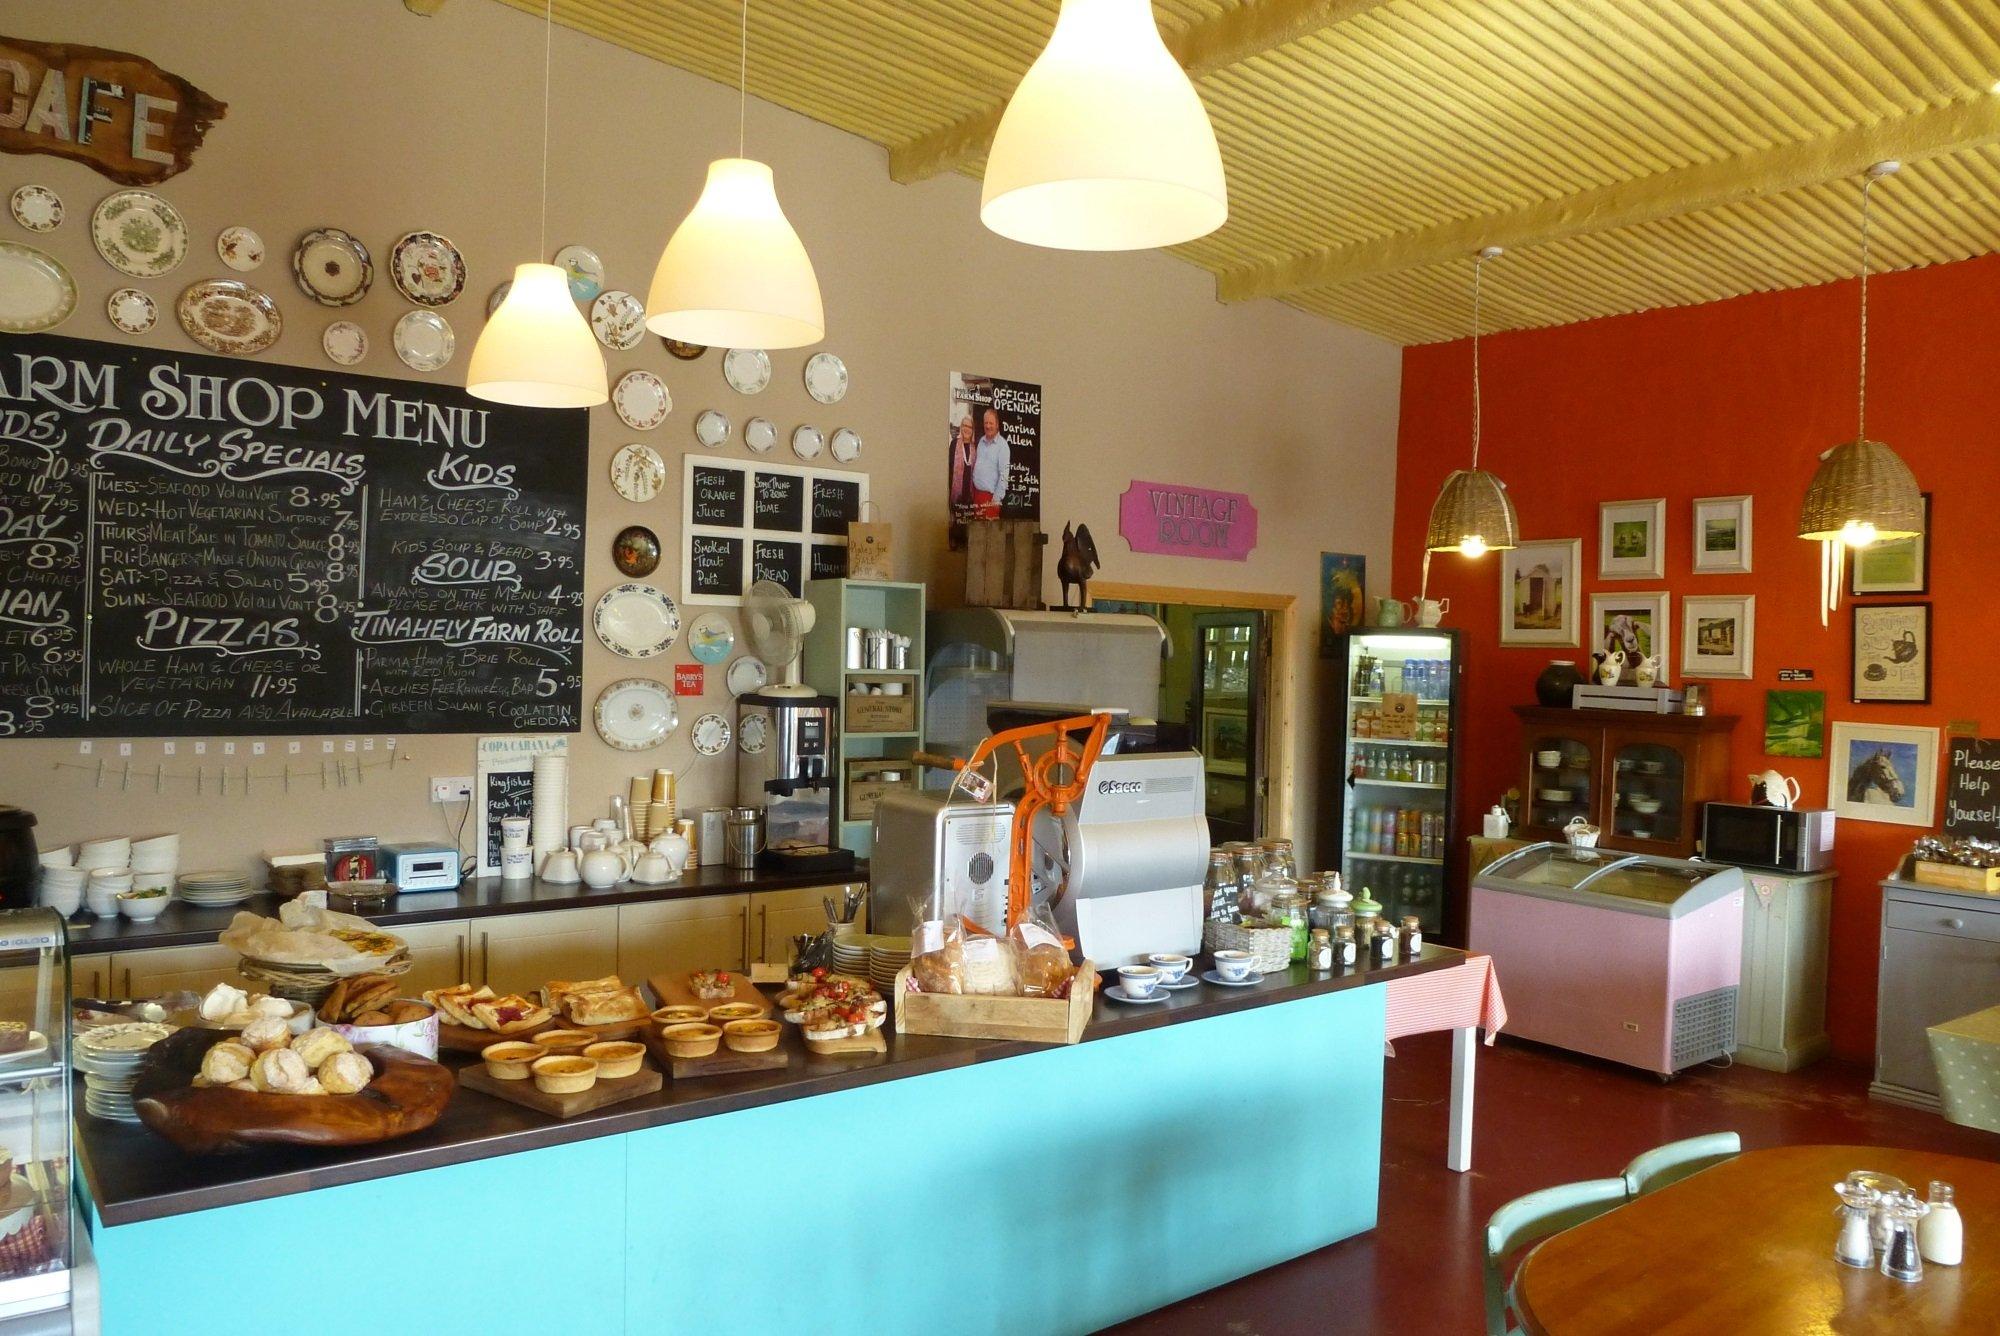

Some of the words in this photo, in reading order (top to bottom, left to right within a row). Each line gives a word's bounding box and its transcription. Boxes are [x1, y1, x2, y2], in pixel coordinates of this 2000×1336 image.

[141, 361, 324, 429] SHOP
[342, 388, 491, 448] MENU
[994, 388, 1040, 405] OFFICIAL
[994, 400, 1040, 417] OPENING
[0, 410, 60, 441] DS
[1002, 422, 1036, 436] Darina
[88, 417, 210, 456] DAILY
[218, 428, 366, 475] SPECIALS
[1007, 434, 1033, 447] Allen
[438, 451, 516, 486] KIDS
[695, 474, 725, 487] FRESH
[1019, 474, 1039, 485] 14th
[289, 487, 341, 509] 8.95
[379, 487, 417, 510] HAM
[436, 492, 497, 513] CHEESE
[700, 488, 736, 501] ORANGE
[814, 484, 844, 500] FRESH
[188, 501, 264, 522] VEGETARIAN
[697, 503, 726, 518] JUICE
[755, 500, 780, 515] HOME
[1148, 489, 1241, 524] VINTAGE
[510, 514, 543, 533] SOUP
[543, 516, 581, 541] 2.95
[391, 540, 428, 554] KIDS
[431, 539, 471, 554] SOUP
[534, 550, 574, 571] 3.95
[755, 543, 785, 560] FRESH
[419, 553, 517, 581] SOUP
[755, 562, 790, 583] BREAD
[151, 569, 203, 587] PIZZA
[287, 573, 329, 595] 5.95
[160, 588, 228, 608] SEAFOOD
[370, 582, 429, 600] ALWAYS
[437, 589, 457, 600] ON
[460, 589, 490, 600] THE
[494, 585, 543, 600] MENU
[547, 584, 584, 608] 4.95
[386, 598, 438, 612] PLEASE
[491, 604, 524, 615] WITH
[145, 607, 300, 647] PIZZAS
[354, 610, 470, 640] TINAHELY
[468, 616, 531, 642] FARM
[533, 618, 583, 645] ROLL
[14, 652, 76, 678] PASTRY
[43, 646, 84, 664] 6.95
[98, 658, 157, 674] WHOLE
[166, 656, 203, 674] HAM
[229, 656, 296, 675] CHEESE
[459, 648, 499, 667] BRIE
[504, 647, 548, 668] ROLL
[120, 676, 236, 693] VEGETARIAN
[250, 675, 297, 698] 11.95
[369, 679, 429, 697] ARCHIES
[534, 668, 582, 698] 5.95
[26, 695, 80, 719] 8.95
[155, 701, 180, 717] OF
[186, 699, 232, 719] PIZZA
[276, 699, 353, 720] AVAILABLE
[437, 697, 483, 713] SALAMI
[513, 716, 579, 731] CHEDDAR
[1954, 749, 2000, 771] Please
[1108, 780, 1143, 794] Saeco
[1959, 773, 1990, 797] Help
